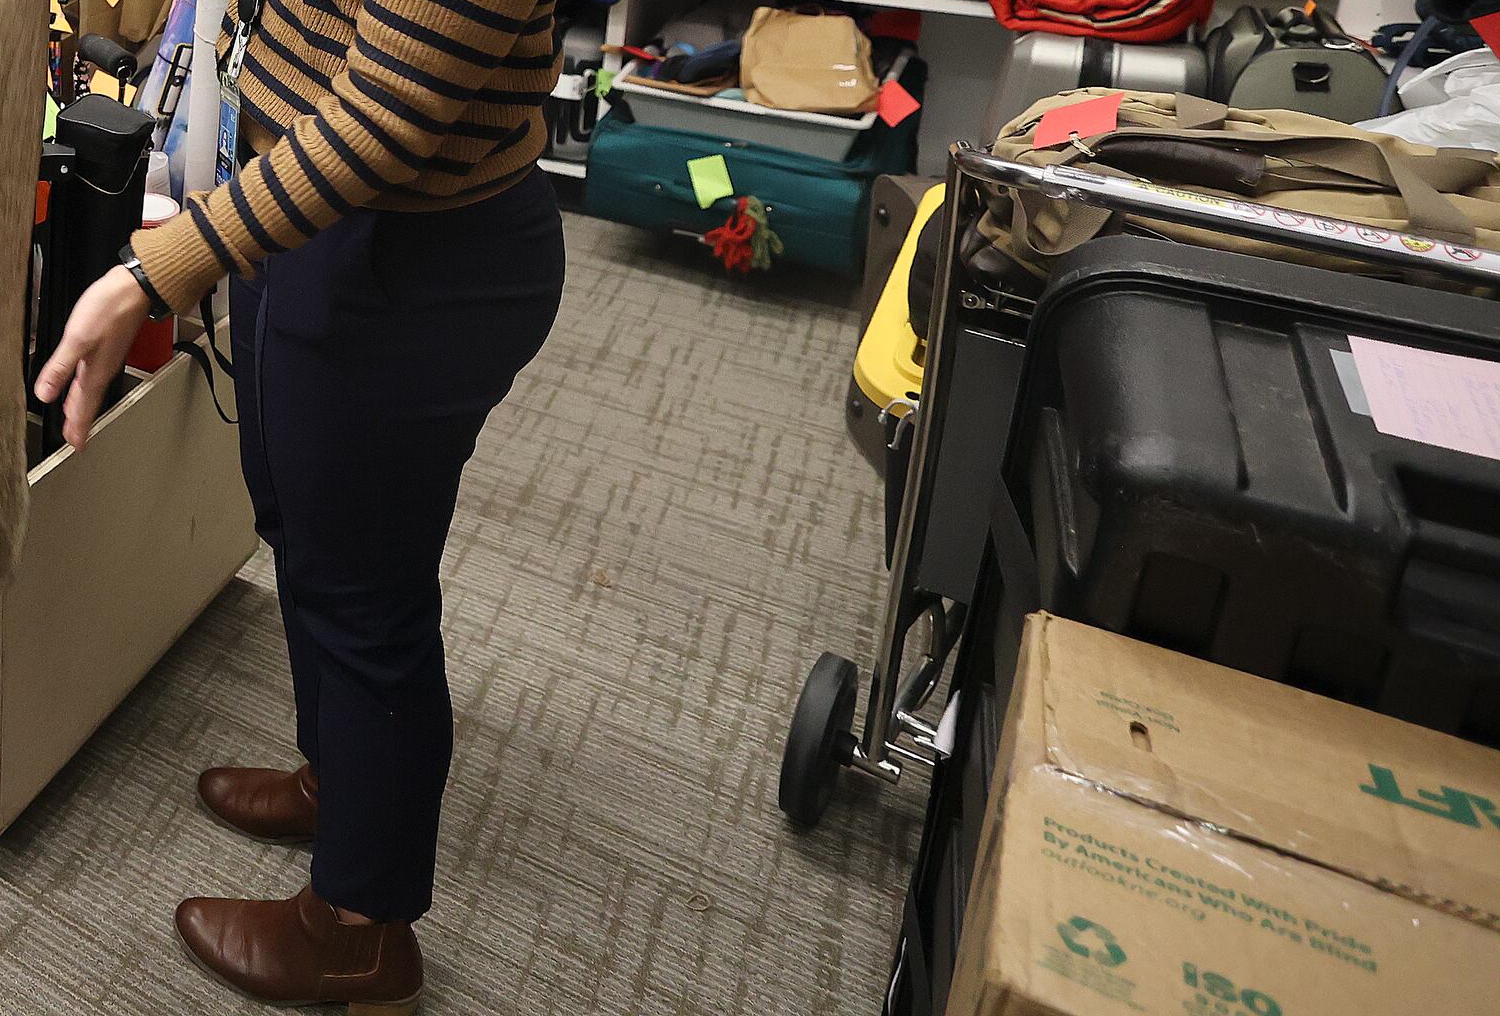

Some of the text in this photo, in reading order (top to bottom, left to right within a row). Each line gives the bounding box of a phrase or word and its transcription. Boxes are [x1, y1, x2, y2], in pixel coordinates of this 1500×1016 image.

[1043, 815, 1372, 955] Products Created With Pride
[1043, 830, 1379, 974] By Americans Who Are Blind
